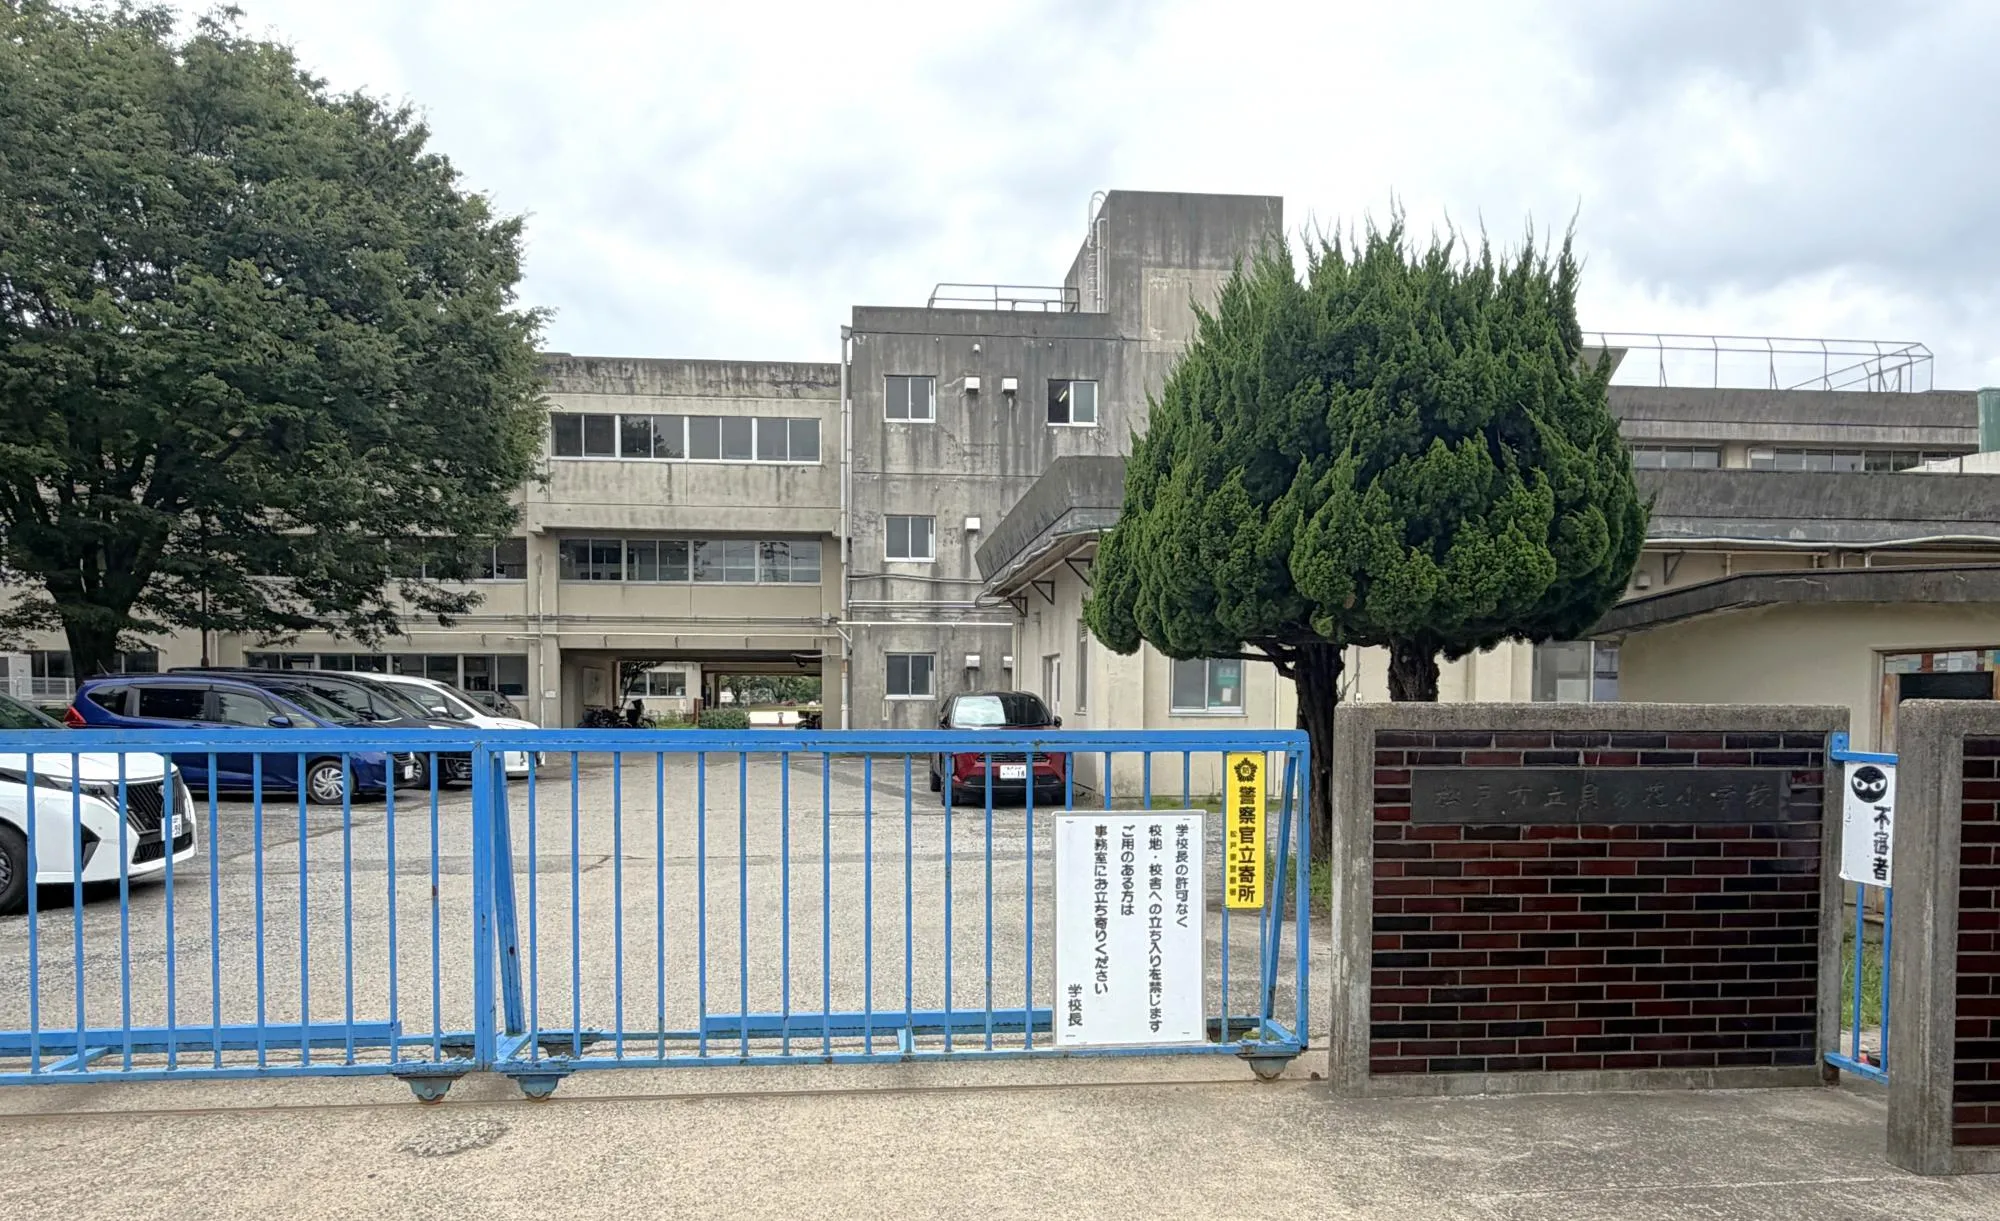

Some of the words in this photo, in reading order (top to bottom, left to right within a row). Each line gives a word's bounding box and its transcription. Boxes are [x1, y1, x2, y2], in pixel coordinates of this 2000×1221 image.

[1120, 824, 1136, 916] ご用のある方は
[1175, 824, 1189, 928] 学校長の許可なく
[1238, 786, 1256, 903] 警察官立寄所
[1094, 824, 1109, 995] 事務室にお立ち寄りください
[1148, 824, 1163, 1033] 校地・校舎への立ち入りを禁じます
[1067, 983, 1083, 1027] 学校長
